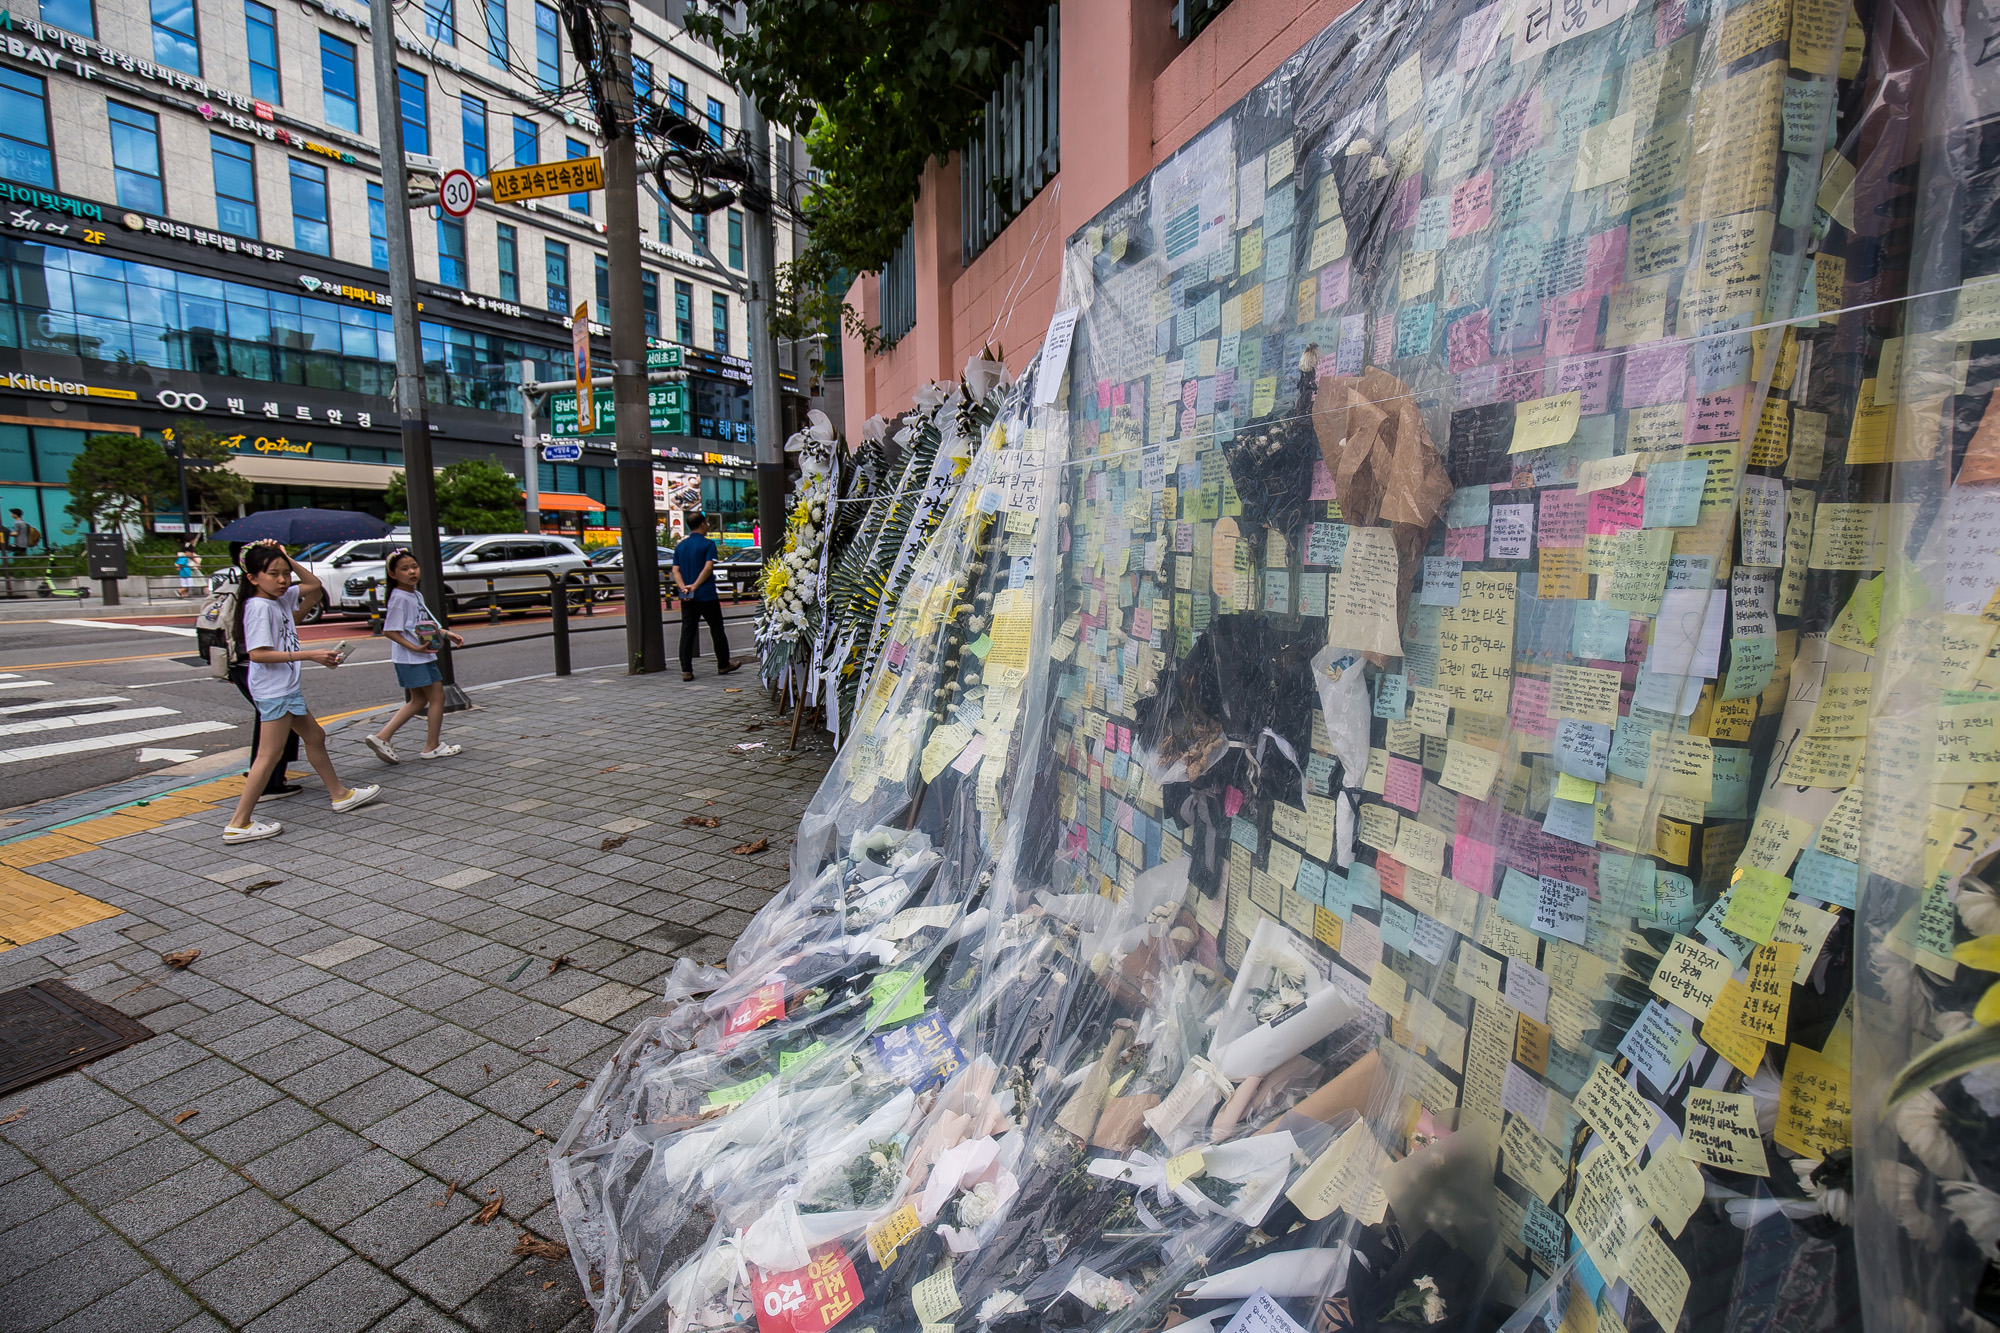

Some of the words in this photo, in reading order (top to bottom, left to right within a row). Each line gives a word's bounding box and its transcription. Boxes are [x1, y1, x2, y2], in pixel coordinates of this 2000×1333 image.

[21, 18, 88, 56] 제이엠
[216, 87, 250, 112] 의원
[73, 60, 98, 79] 1F
[496, 163, 598, 198] 신호과속단속장비
[447, 182, 469, 205] 30
[83, 229, 106, 245] 2F
[145, 217, 191, 241] 루아의
[194, 229, 237, 254] 뷰티랩
[266, 248, 284, 262] 2F
[647, 352, 678, 364] 서이초교
[8, 372, 89, 397] Kitchen
[227, 398, 372, 428] 빈센트안경
[254, 436, 312, 454] Optical
[997, 450, 1043, 469] 서비스
[1009, 493, 1038, 512] 보장
[1440, 631, 1458, 651] 진상
[1438, 658, 1465, 676] 교권이
[1471, 663, 1488, 679] 없는
[1674, 940, 1719, 970] 지켜주지
[1680, 958, 1702, 980] 못해
[1658, 970, 1714, 1010] 미안합니다.
[914, 1018, 948, 1055] 교사
[1691, 1098, 1714, 1114] 선생님,
[806, 1250, 854, 1326] 생존권
[1254, 1294, 1280, 1318] 선생님,
